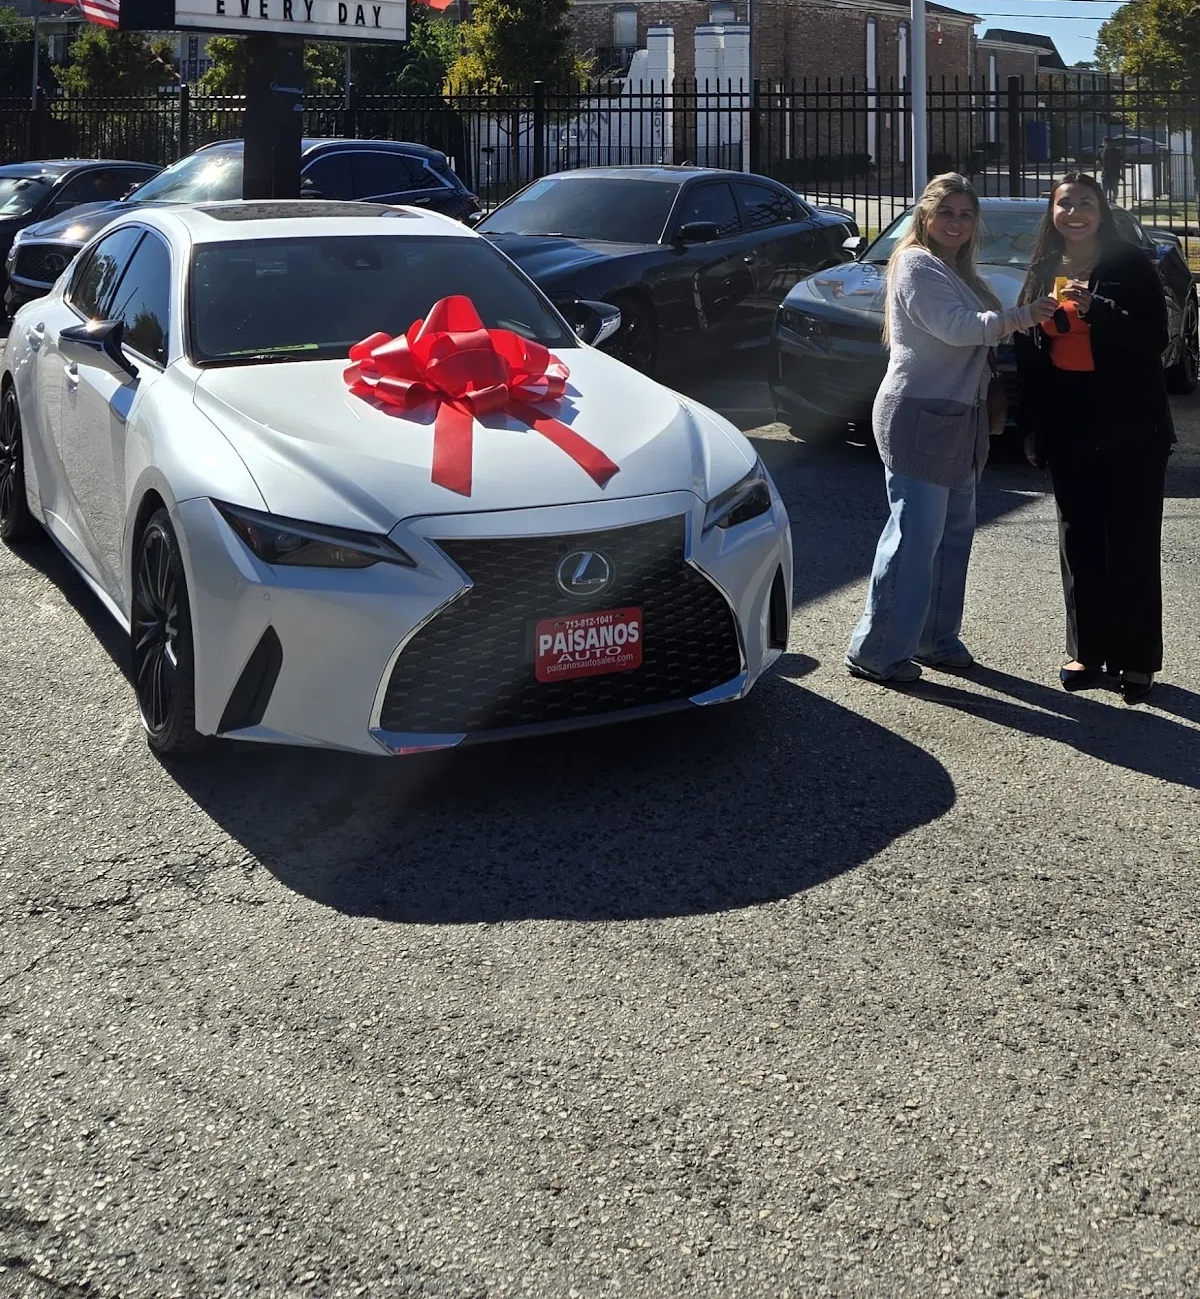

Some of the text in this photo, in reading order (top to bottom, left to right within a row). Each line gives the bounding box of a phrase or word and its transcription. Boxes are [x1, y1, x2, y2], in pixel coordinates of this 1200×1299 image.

[338, 2, 382, 28] DAY
[565, 614, 613, 630] 713-812-1041
[547, 653, 634, 674] paisanosautosales.com
[558, 646, 622, 663] AUTO
